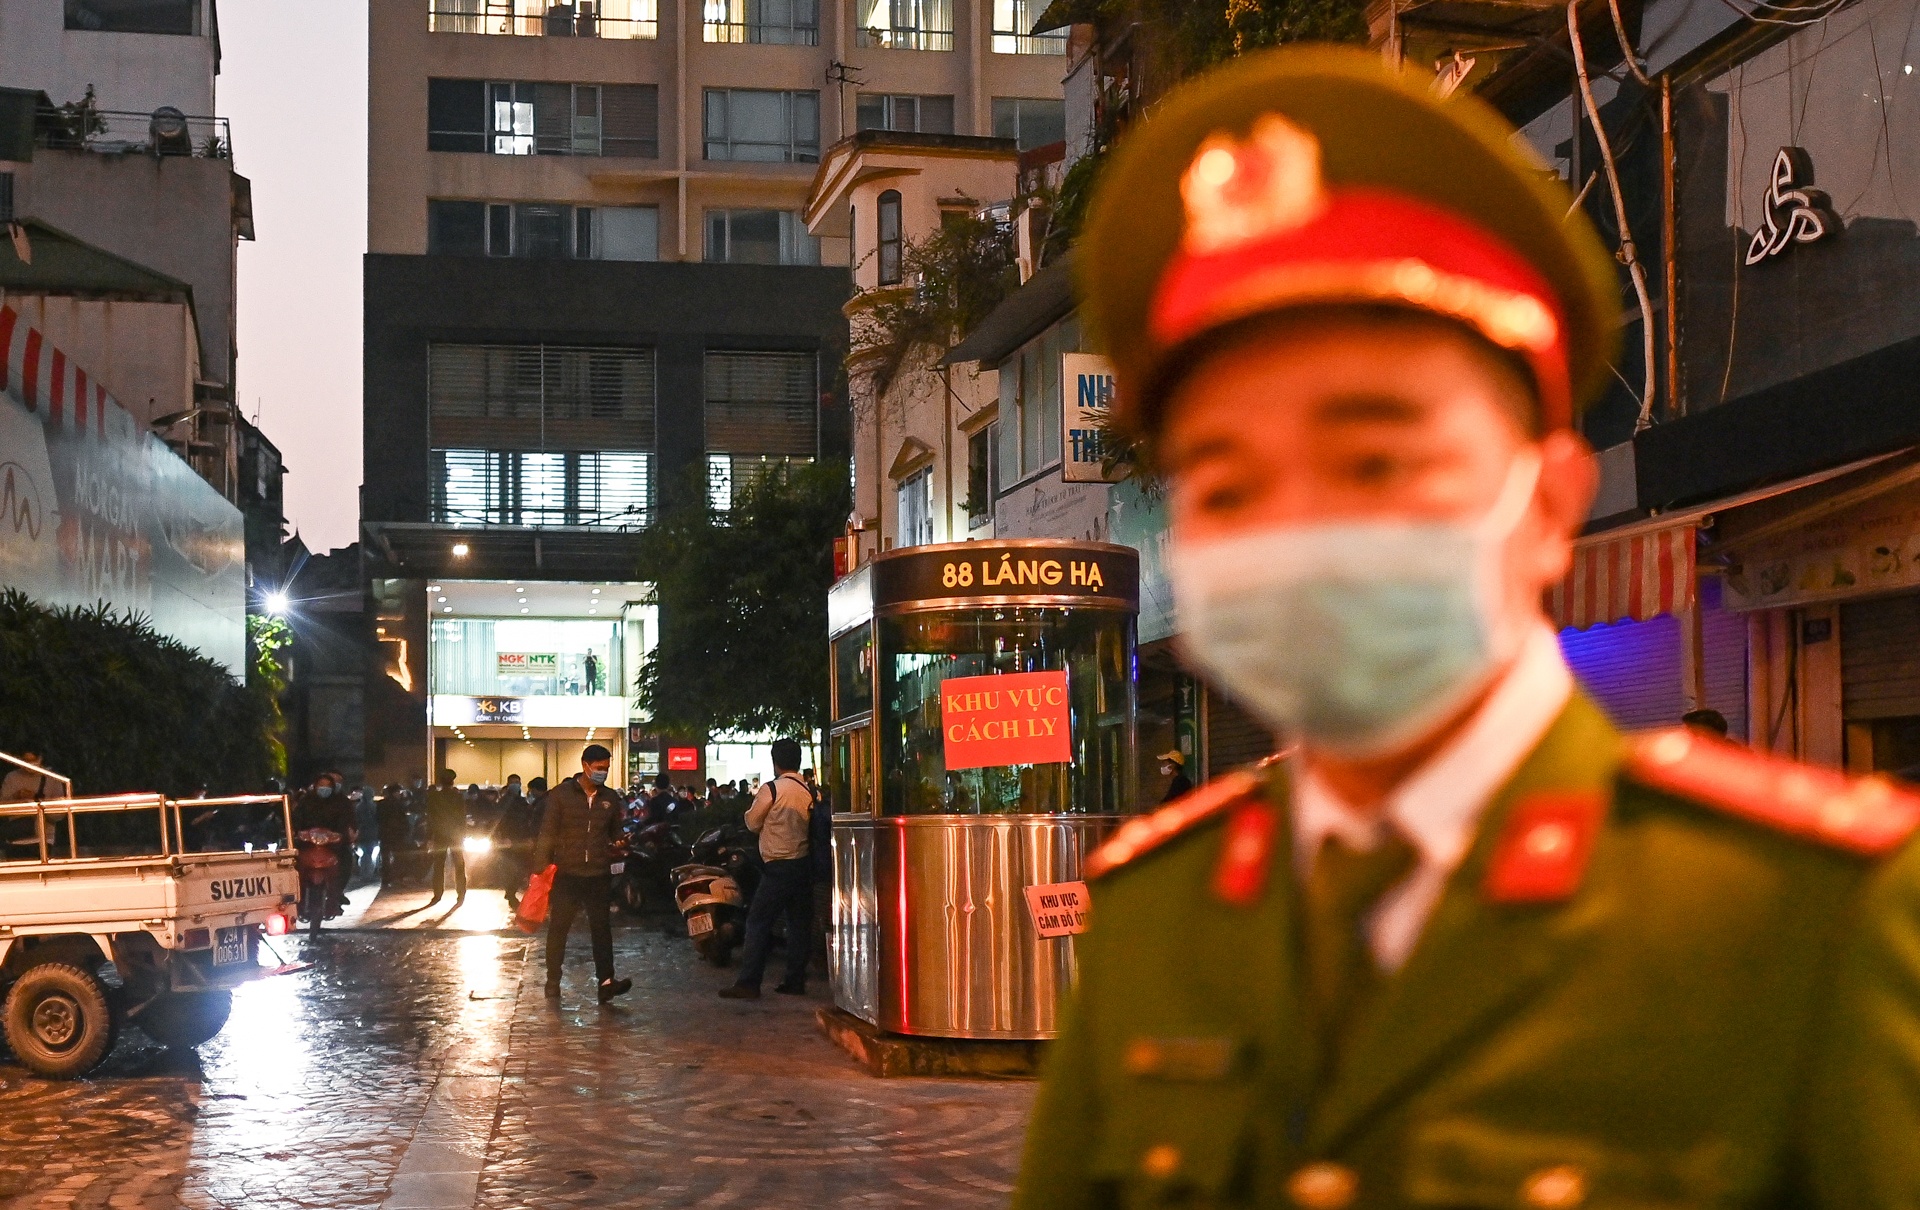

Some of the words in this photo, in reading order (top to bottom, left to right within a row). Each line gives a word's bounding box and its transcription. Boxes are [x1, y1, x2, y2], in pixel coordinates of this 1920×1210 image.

[1078, 374, 1112, 407] NH
[1069, 429, 1104, 462] TH
[942, 562, 974, 588] 88
[982, 552, 1063, 586] LÁNG
[1070, 561, 1104, 592] HẠ
[498, 654, 525, 664] NGK
[529, 654, 556, 664] NTK
[500, 701, 521, 713] KB
[947, 690, 1000, 714] KHU
[1007, 684, 1063, 712] VỰC
[948, 717, 1020, 743] CÁCH
[1027, 717, 1058, 738] LY
[210, 876, 272, 900] SUZUKI
[1040, 894, 1059, 909] KHU
